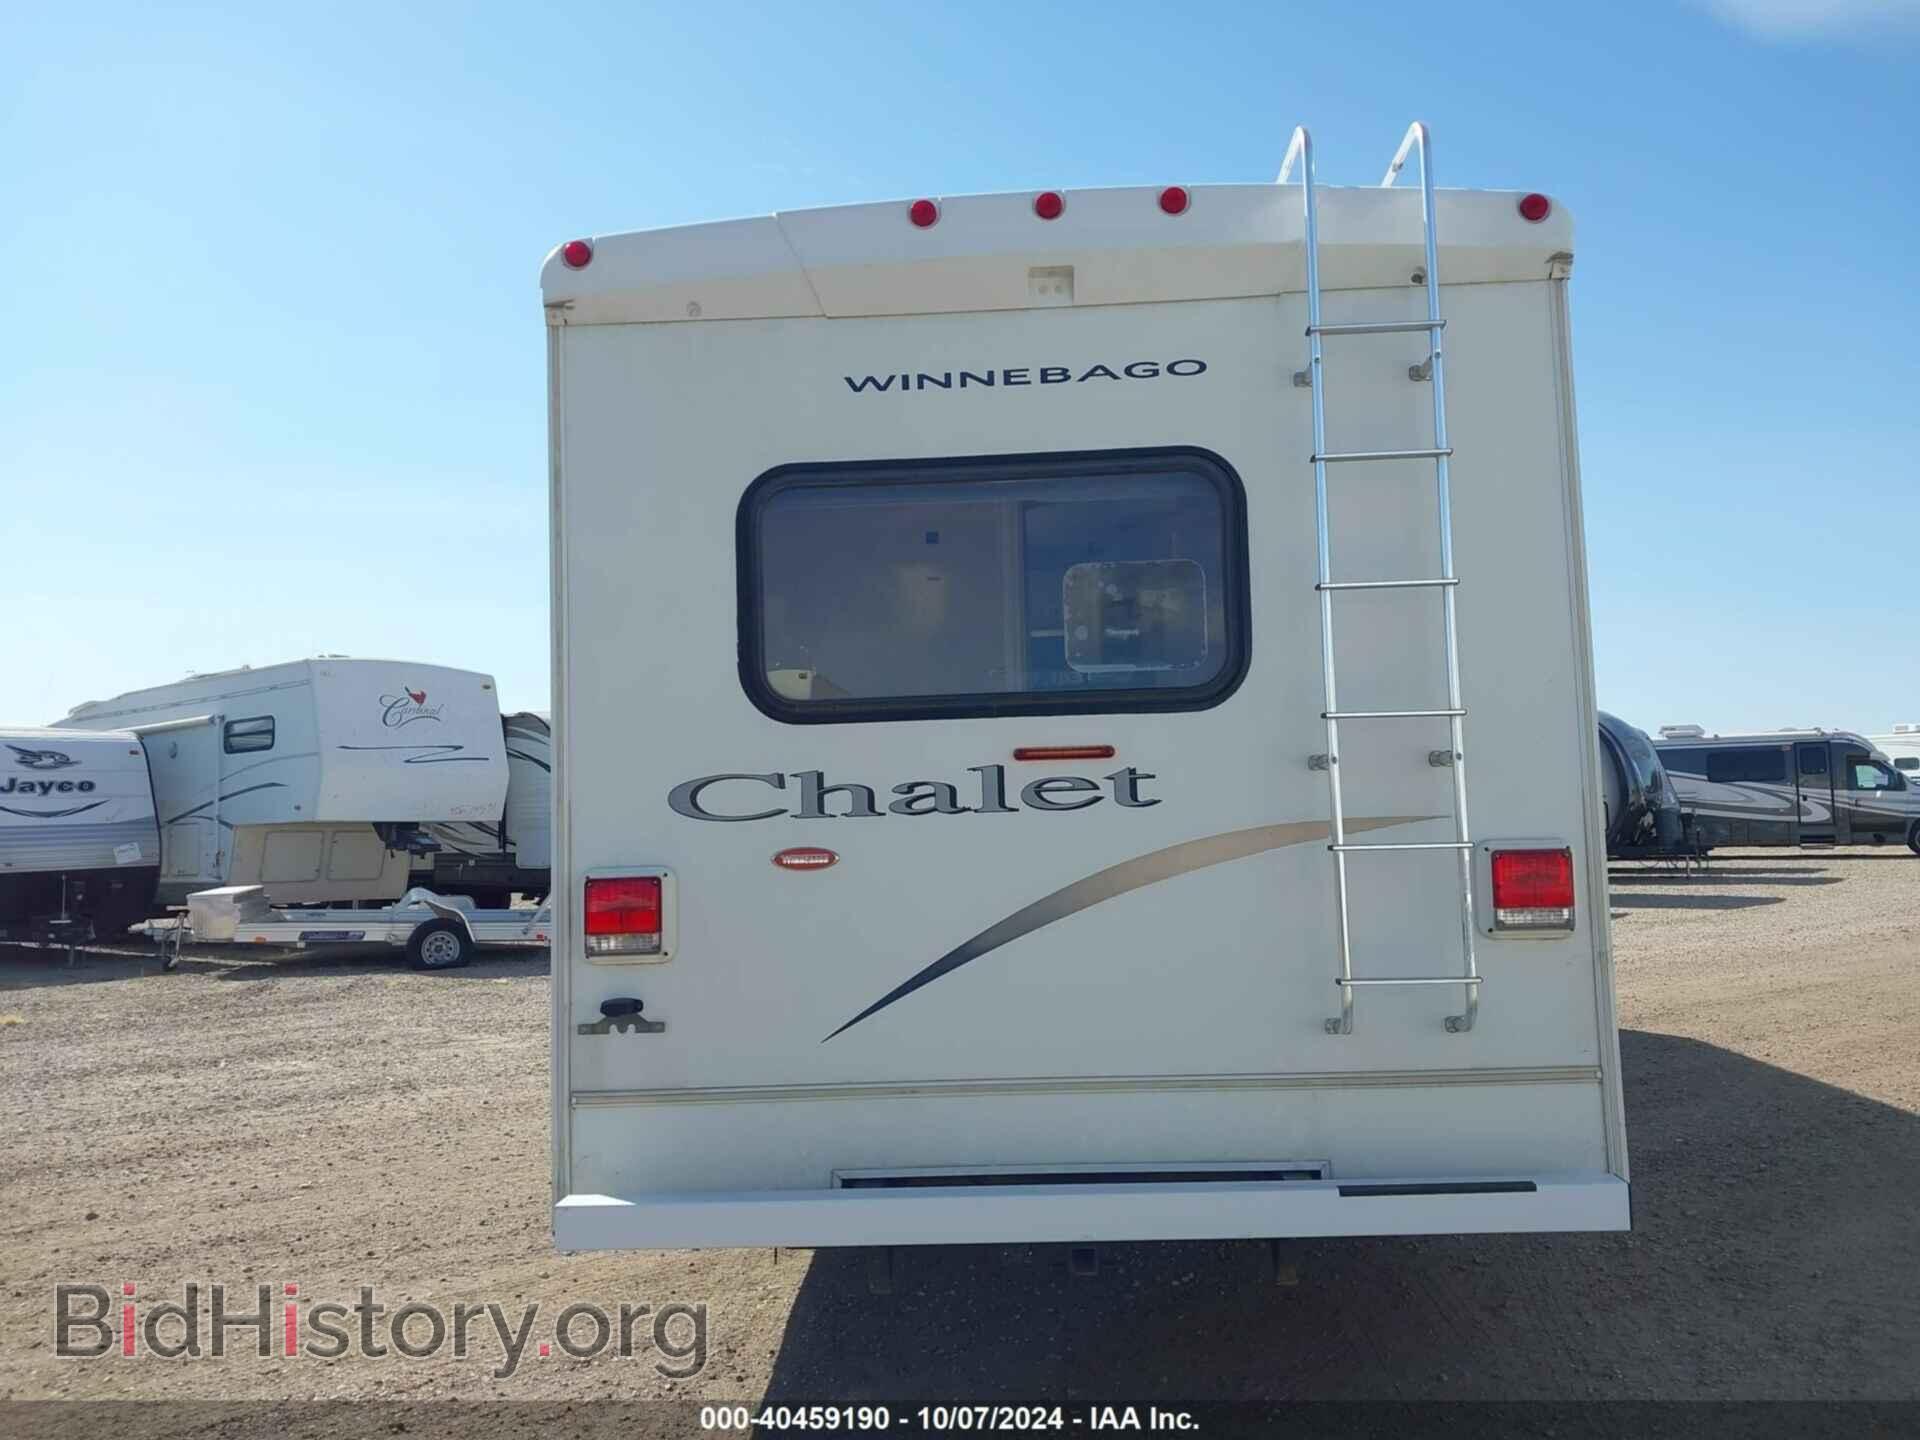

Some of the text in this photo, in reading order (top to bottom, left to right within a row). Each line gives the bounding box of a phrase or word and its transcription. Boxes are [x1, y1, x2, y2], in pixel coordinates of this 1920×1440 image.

[844, 359, 1208, 393] WINNEBAGO
[0, 777, 96, 796] Jayco
[667, 764, 1162, 822] Chalet
